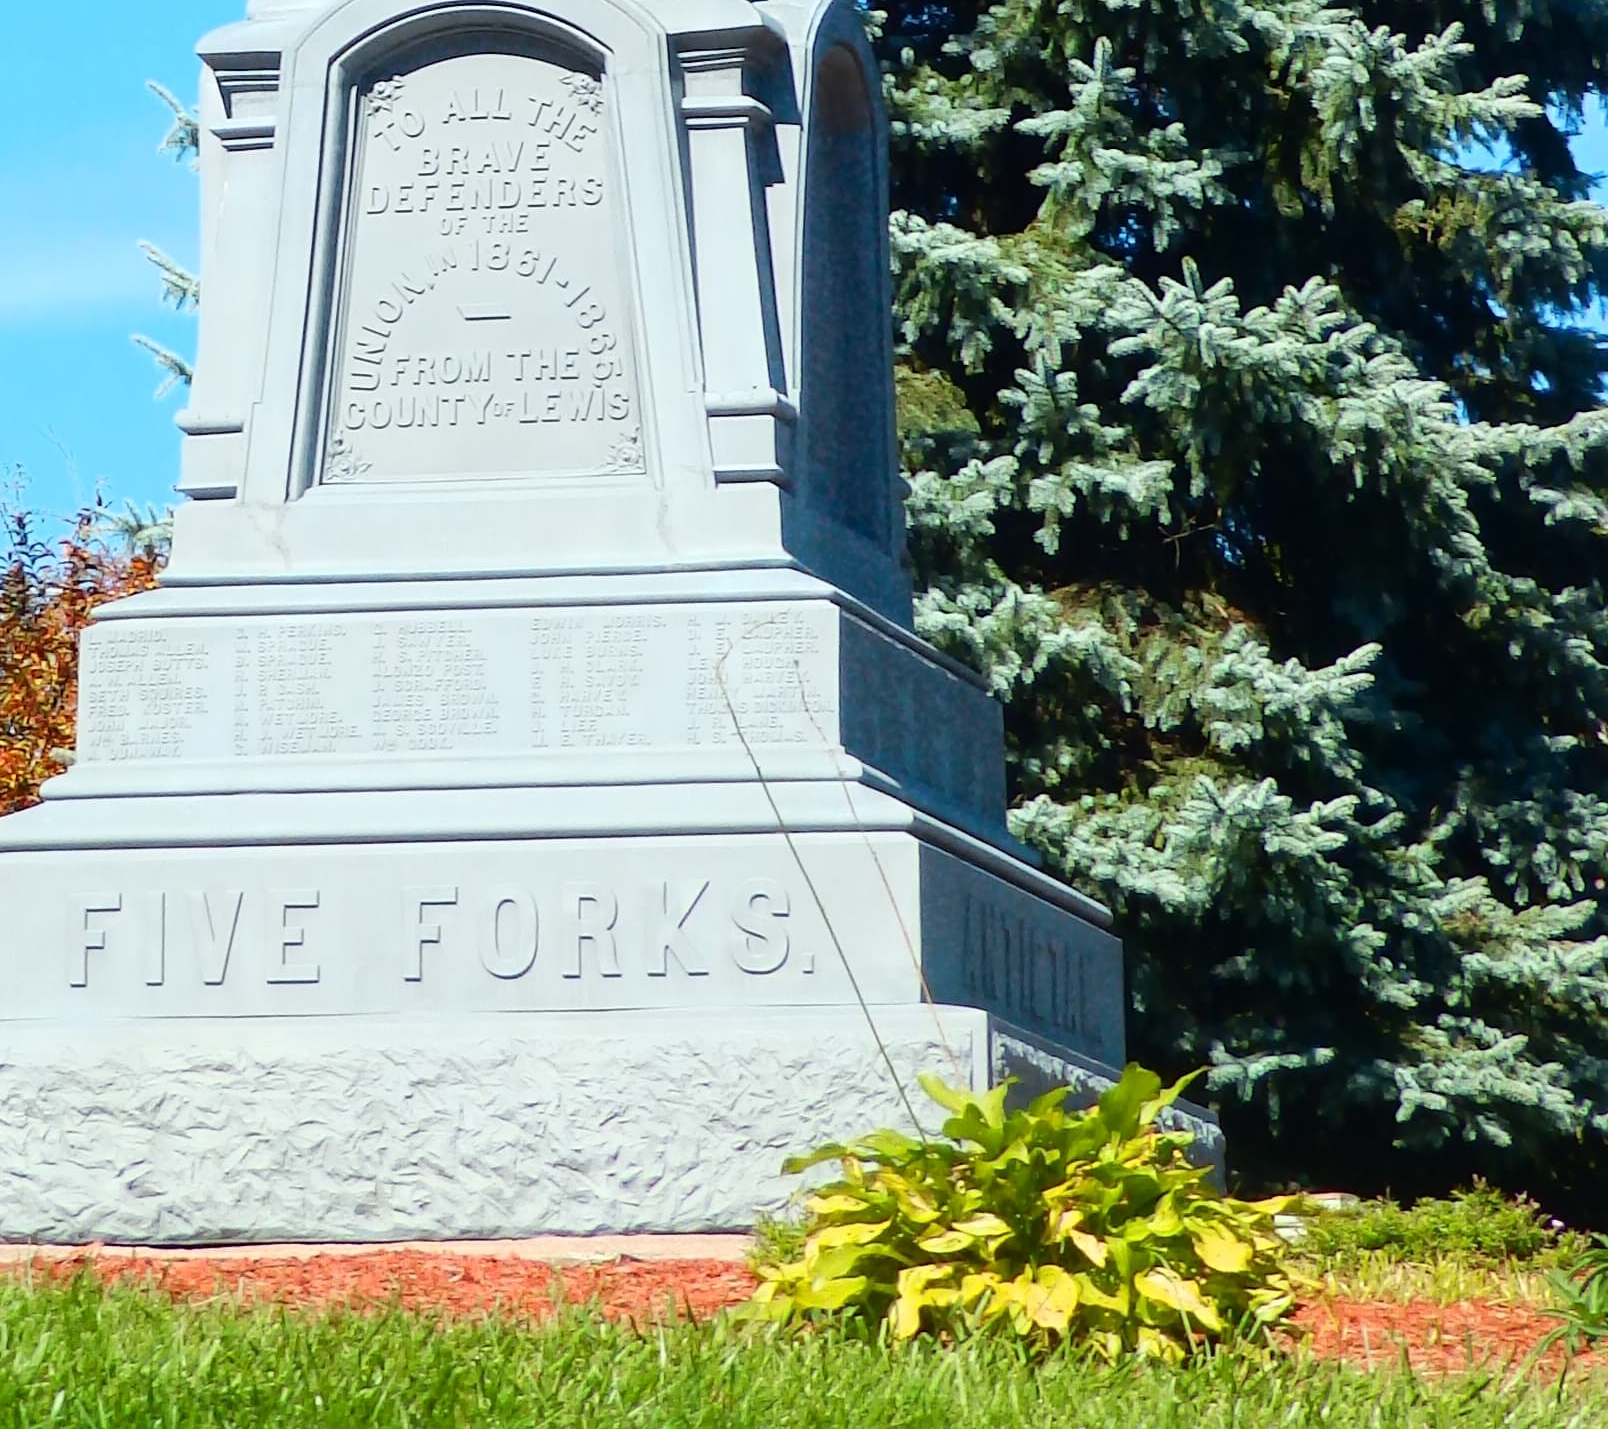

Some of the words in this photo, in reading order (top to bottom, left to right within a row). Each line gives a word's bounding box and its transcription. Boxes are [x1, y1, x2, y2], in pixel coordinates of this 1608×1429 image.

[373, 108, 425, 151] TO
[442, 88, 512, 124] ALL
[527, 96, 598, 152] THE
[417, 141, 552, 177] BRAVE
[366, 177, 604, 214] DEFENDERS
[439, 216, 468, 236] OF
[483, 214, 529, 234] THE
[432, 246, 457, 277] IN
[390, 350, 492, 386] FROM
[506, 348, 580, 383] THE
[344, 393, 495, 430] COUNTY
[493, 399, 515, 419] OF
[517, 390, 630, 424] LEWIS
[68, 887, 321, 989] FIVE
